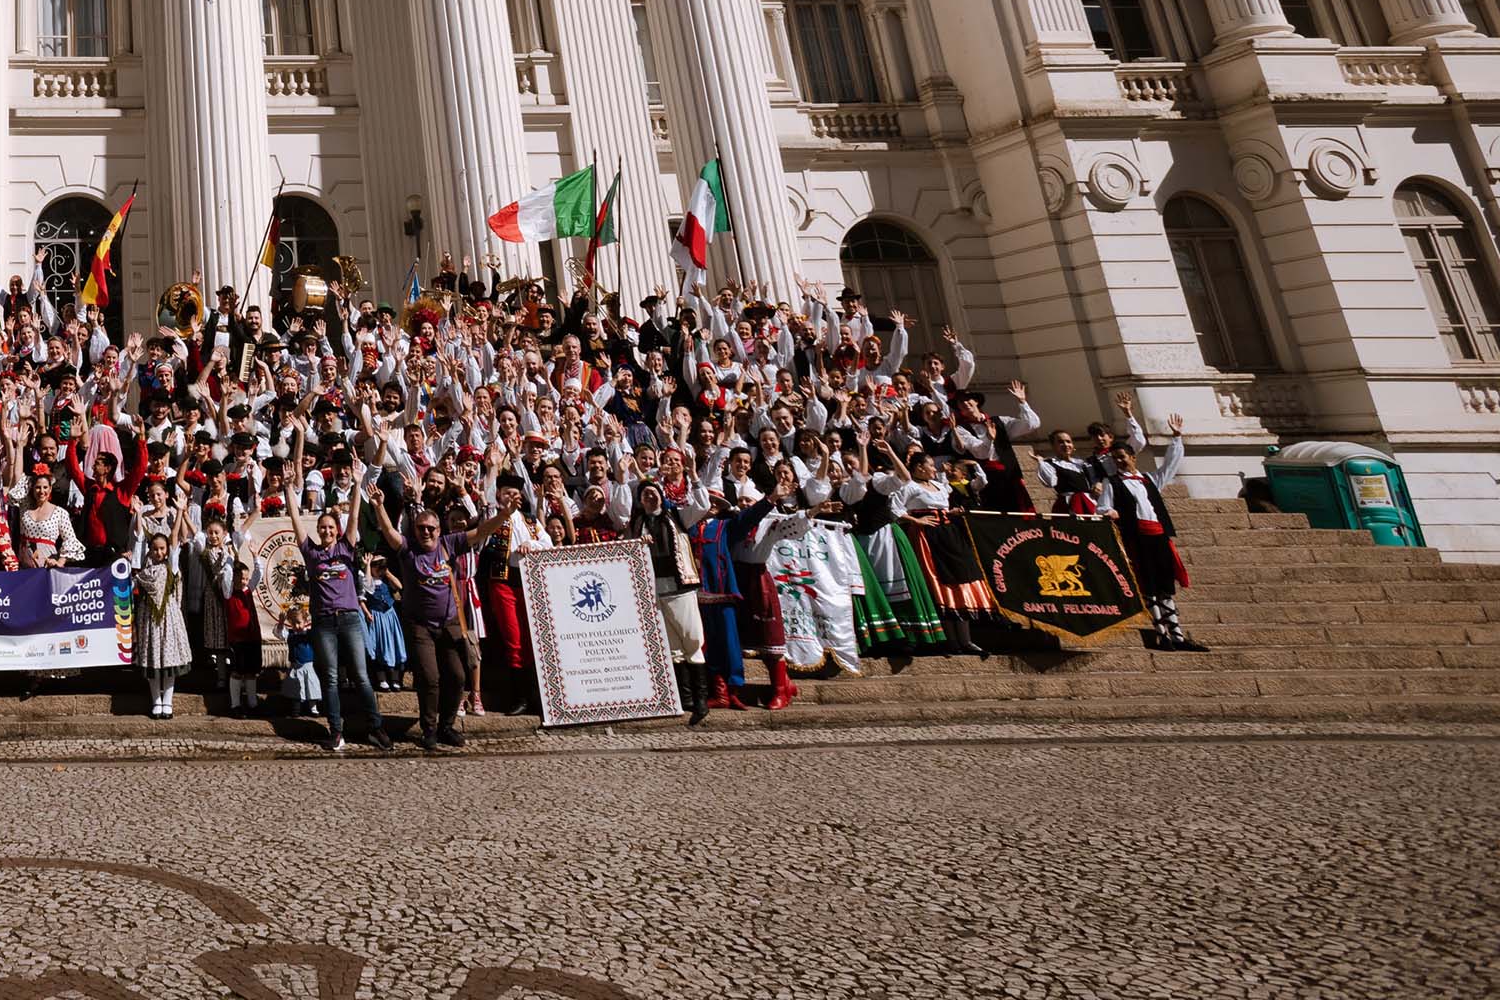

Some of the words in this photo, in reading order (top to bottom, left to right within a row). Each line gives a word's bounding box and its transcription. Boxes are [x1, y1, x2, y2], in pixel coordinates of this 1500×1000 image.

[1050, 525, 1080, 544] ÍTALO
[996, 528, 1043, 559] FOLCLÓRICO
[993, 559, 1007, 592] GRUPO
[55, 605, 73, 615] em
[75, 600, 105, 612] todo
[572, 604, 617, 623] ПОЛТАВА
[1023, 601, 1058, 613] SANTA
[1063, 603, 1122, 616] FELICIDADE
[72, 611, 105, 624] lugar
[560, 631, 588, 641] GRUPO
[578, 638, 624, 648] UCRANIANO
[585, 647, 620, 656] POLTAVA
